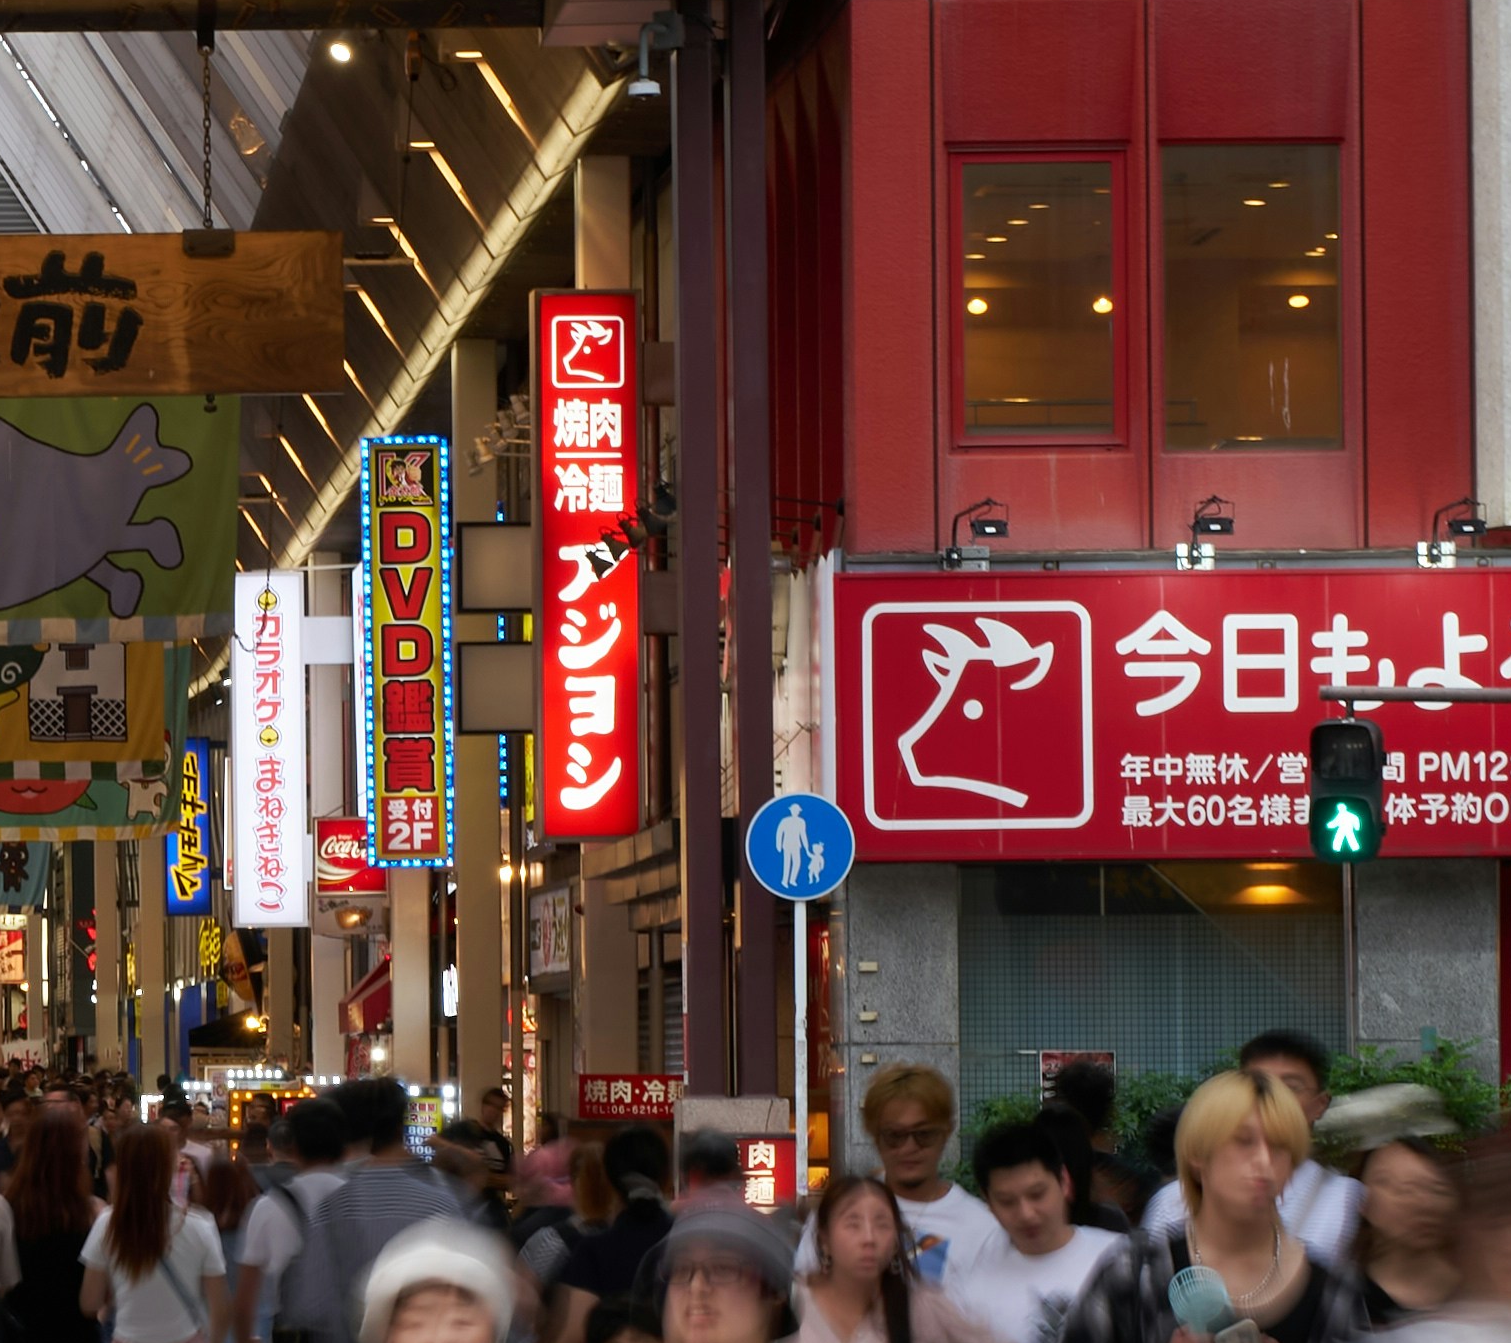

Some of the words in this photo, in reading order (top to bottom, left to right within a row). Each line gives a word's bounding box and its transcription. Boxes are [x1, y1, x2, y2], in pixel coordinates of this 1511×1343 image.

[553, 398, 623, 448] 焼肉
[553, 463, 624, 514] 冷麺
[255, 615, 282, 724] カラオケ
[378, 510, 437, 794] DVD鑑賞
[256, 754, 284, 912] まねきねこ
[387, 798, 434, 821] 受付
[387, 822, 434, 851] 2F
[745, 1140, 776, 1169] 肉
[744, 1176, 776, 1205] 麺
